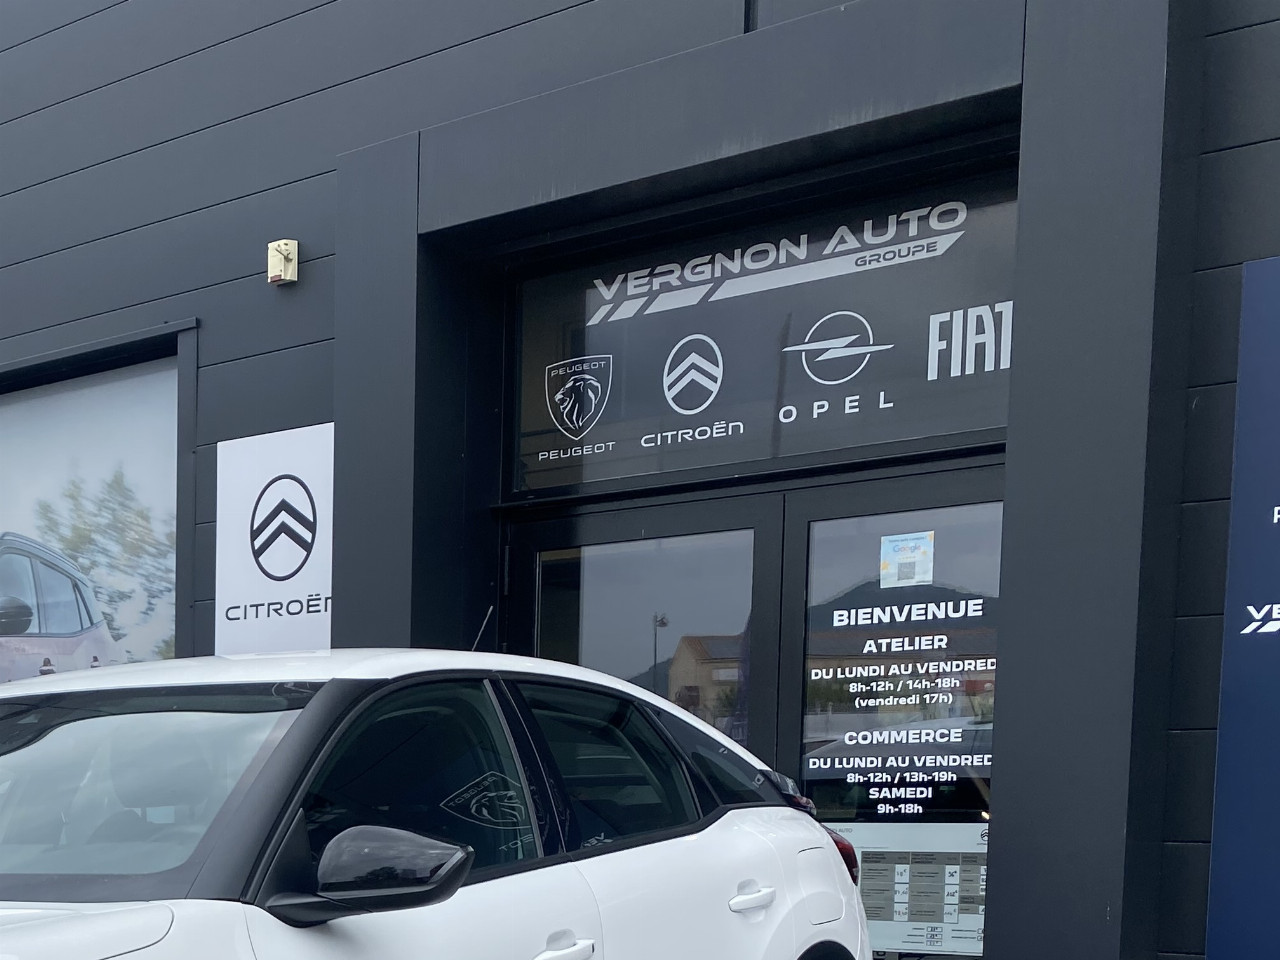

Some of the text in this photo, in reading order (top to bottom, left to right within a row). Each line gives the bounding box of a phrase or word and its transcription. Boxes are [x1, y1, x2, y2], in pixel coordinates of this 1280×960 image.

[592, 201, 968, 300] VERGNON AUTO
[854, 241, 938, 268] GROUPE
[927, 300, 1014, 381] FIAT
[550, 360, 607, 377] PEUGEOT
[778, 391, 894, 424] OPEL
[640, 420, 744, 448] CITROËN
[538, 441, 616, 460] PEUGEOT
[832, 598, 984, 627] BIENVENUE
[862, 634, 948, 654] ATELIER
[811, 658, 997, 680] DU LUNDI AU VENDRED
[849, 681, 894, 694] 8h-12h
[906, 677, 960, 690] 14h-18h
[854, 692, 953, 709] (vendredi 17h)
[844, 728, 963, 746] COMMERCE
[808, 754, 993, 769] DU LUNDI AU VENDRED
[846, 772, 892, 783] 8h-12h
[903, 771, 957, 782] 13h-19h
[868, 787, 933, 799] SAMEDI
[877, 803, 923, 814] 9h-18h
